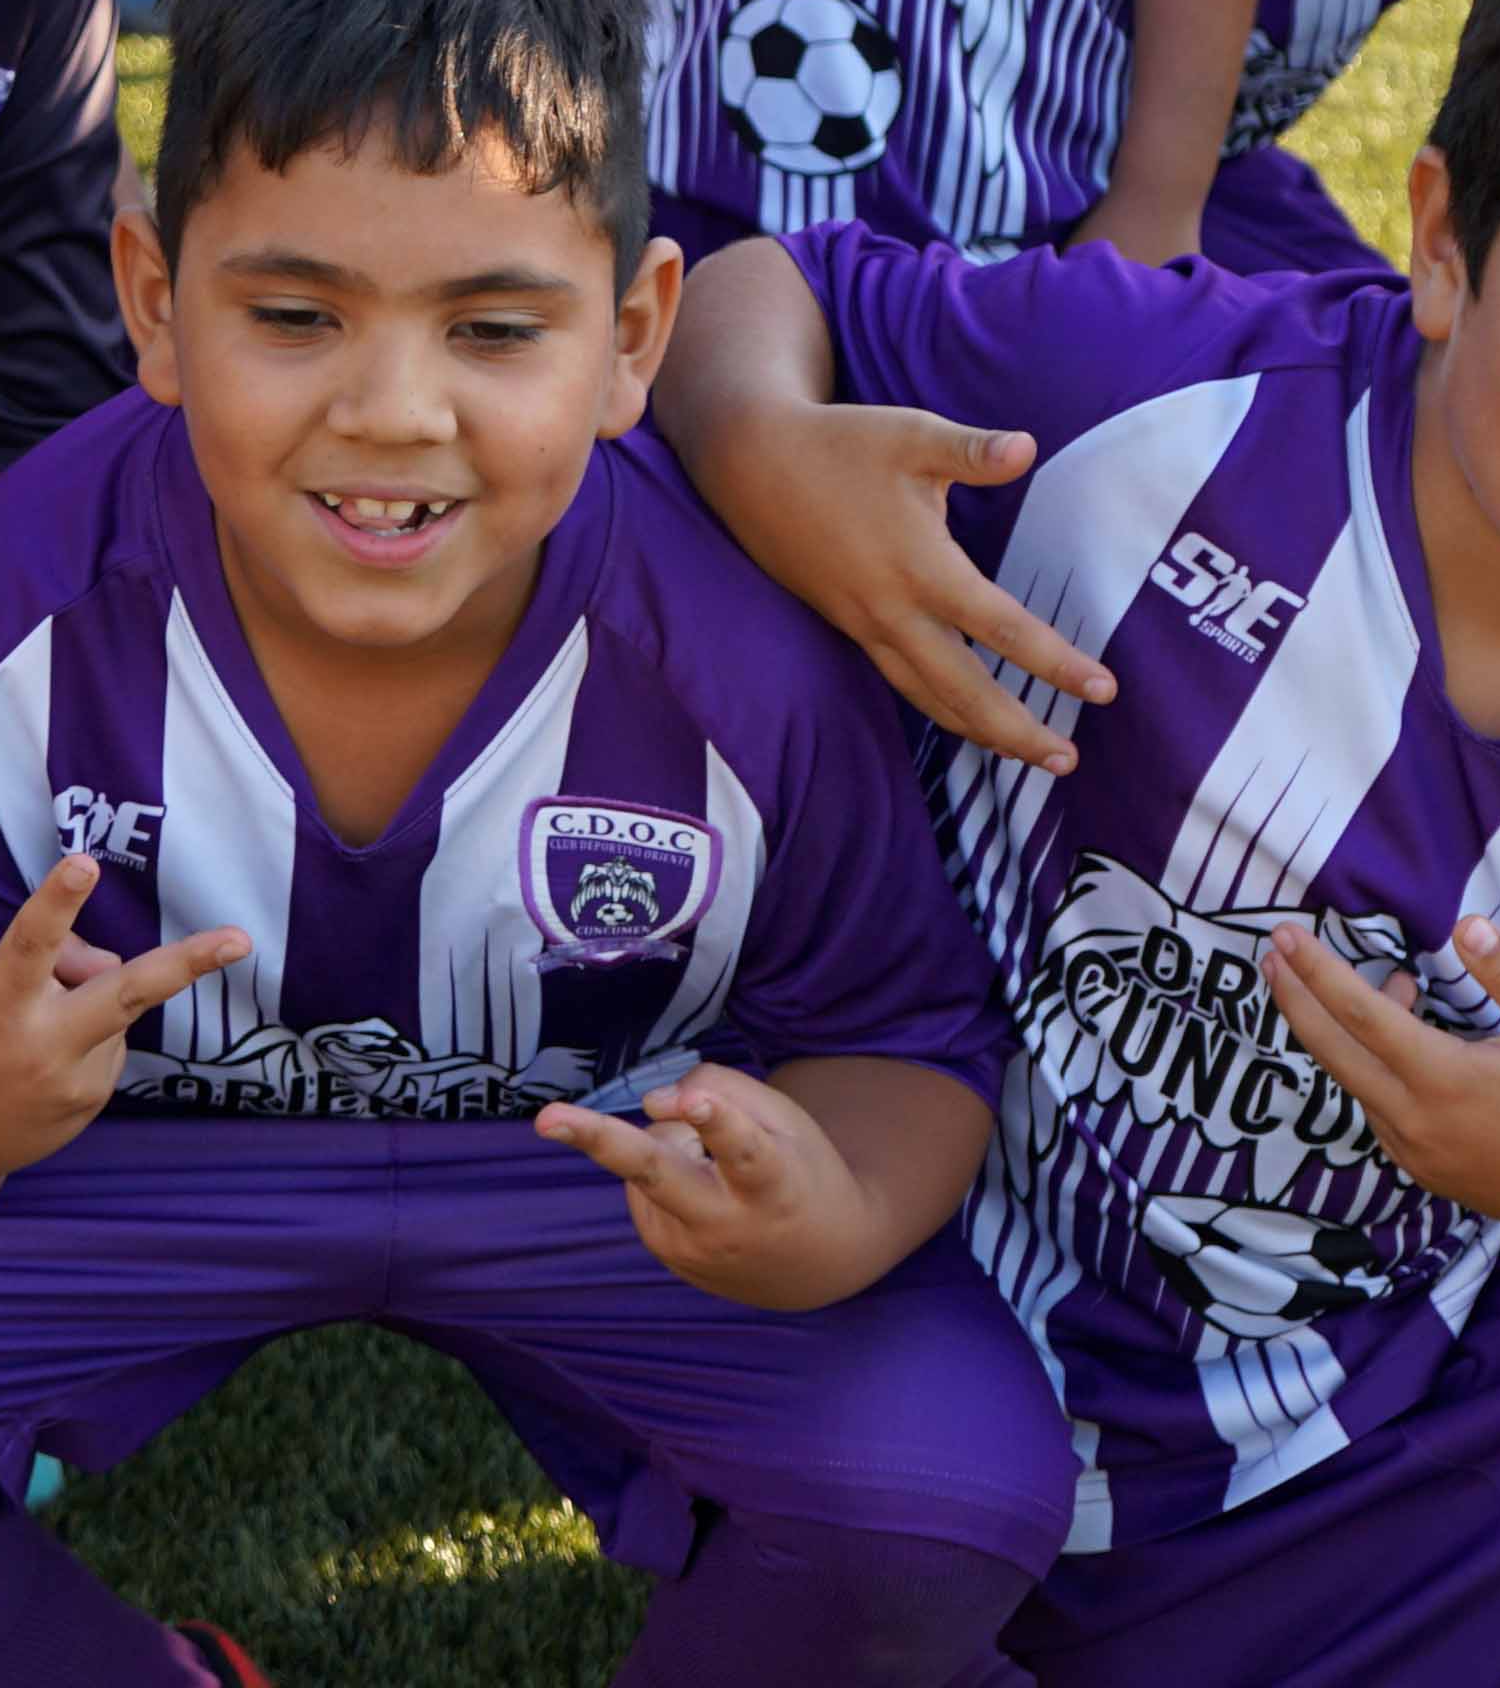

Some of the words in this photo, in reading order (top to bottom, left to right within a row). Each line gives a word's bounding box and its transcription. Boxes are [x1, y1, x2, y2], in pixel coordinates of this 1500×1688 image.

[1197, 618, 1260, 665] SPORTS
[550, 813, 696, 852] C.D.O.C
[550, 838, 578, 851] CLUB
[579, 840, 642, 859] DEPORTIVO
